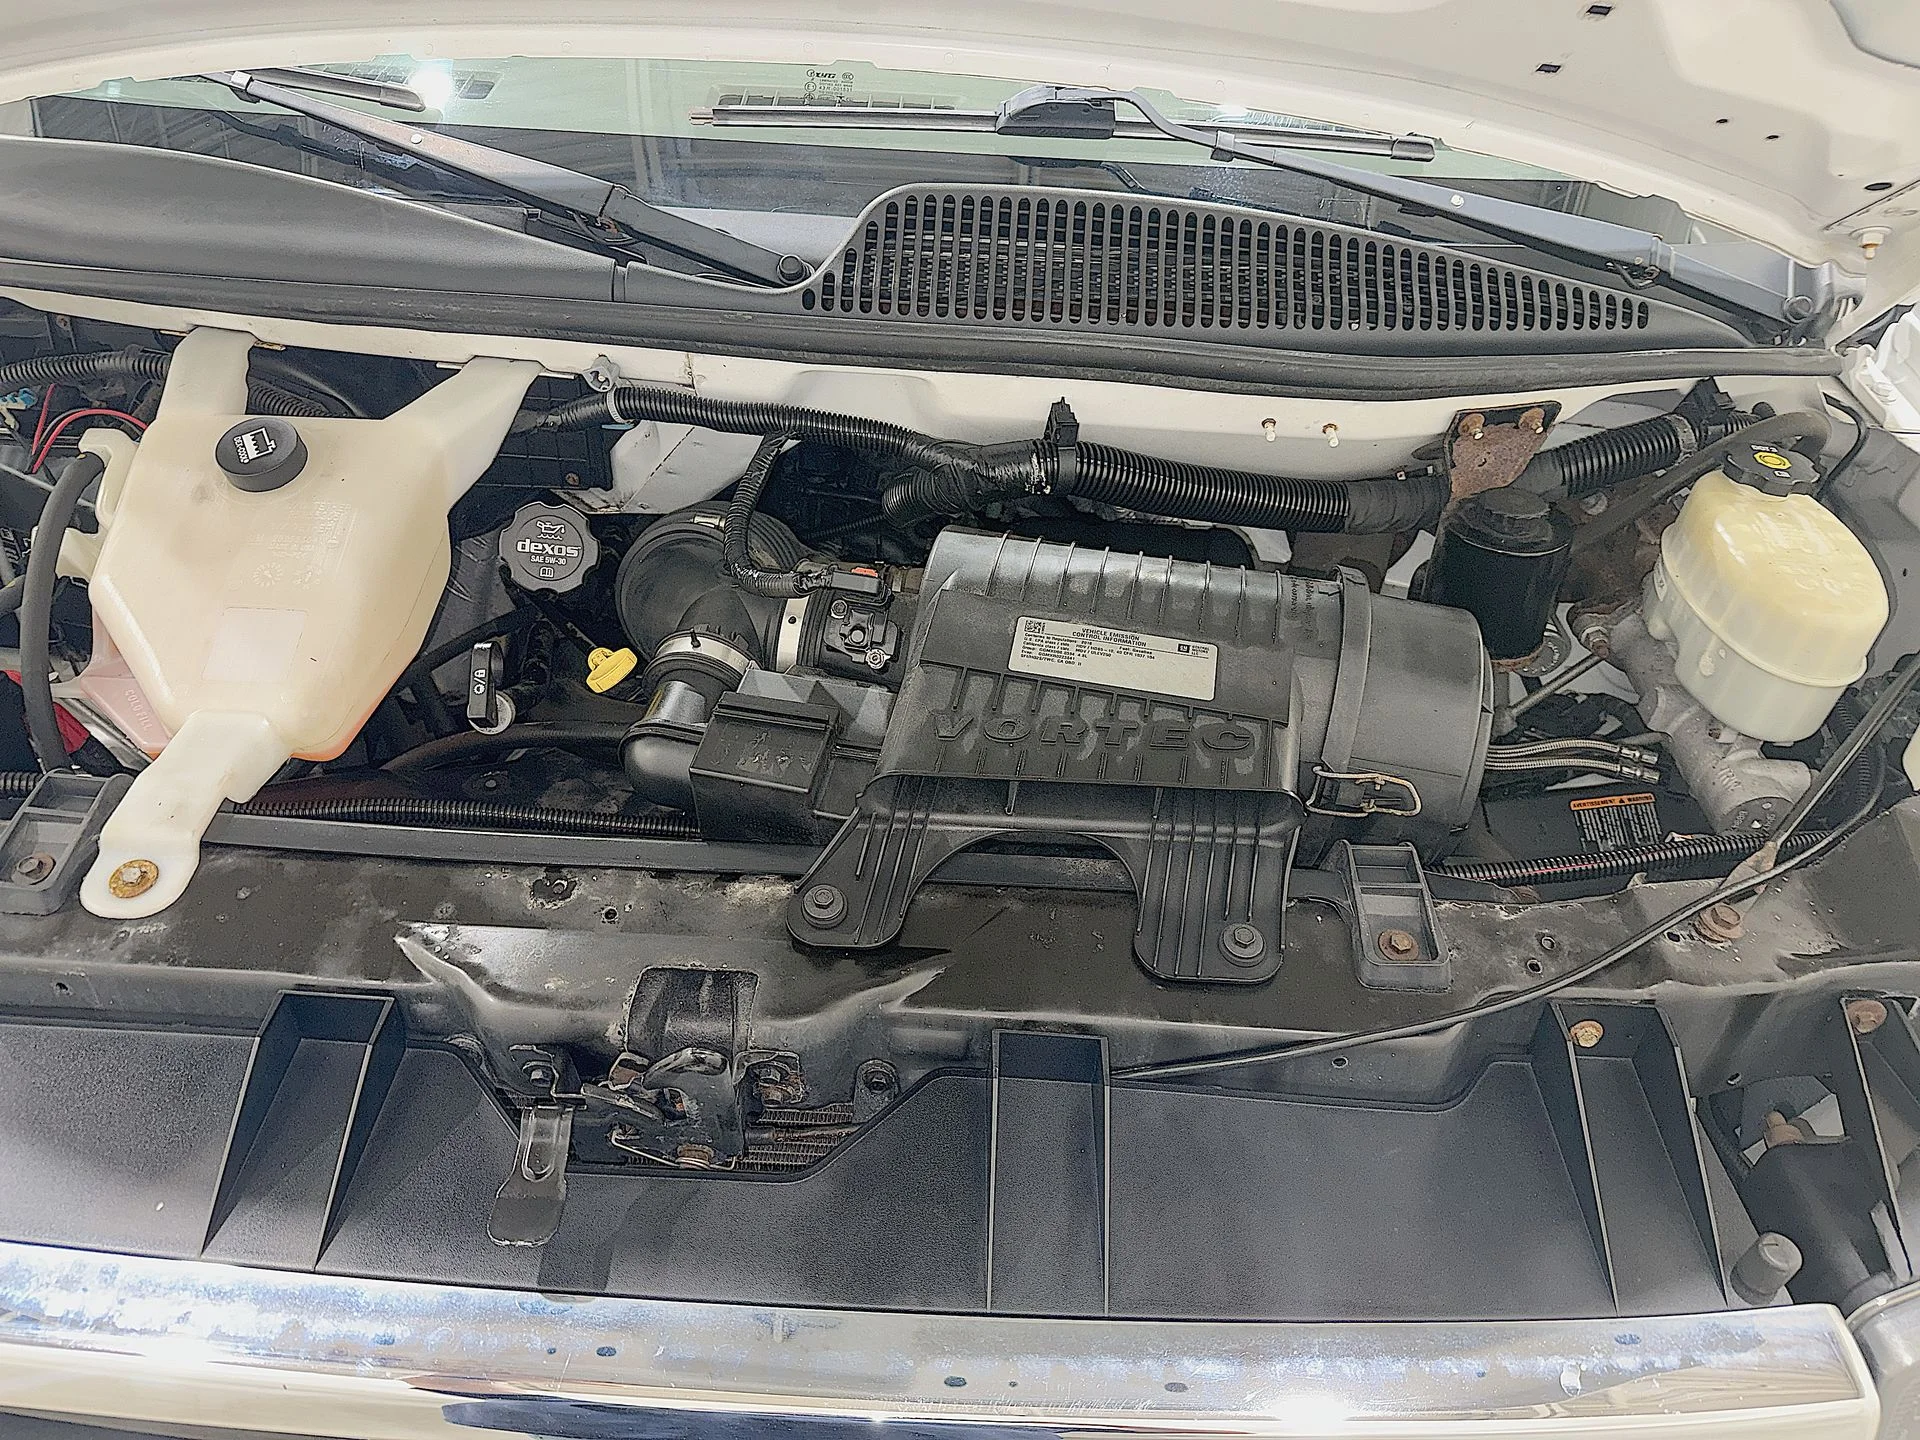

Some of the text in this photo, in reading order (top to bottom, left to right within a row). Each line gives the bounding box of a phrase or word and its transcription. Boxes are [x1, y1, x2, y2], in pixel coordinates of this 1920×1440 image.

[516, 538, 580, 558] dexos
[530, 555, 567, 566] SAE 5W-30
[1072, 632, 1146, 646] CONTROL INFORMATION
[1082, 628, 1140, 641] VEHICLE EMISSION
[934, 713, 1255, 750] VORTEC
